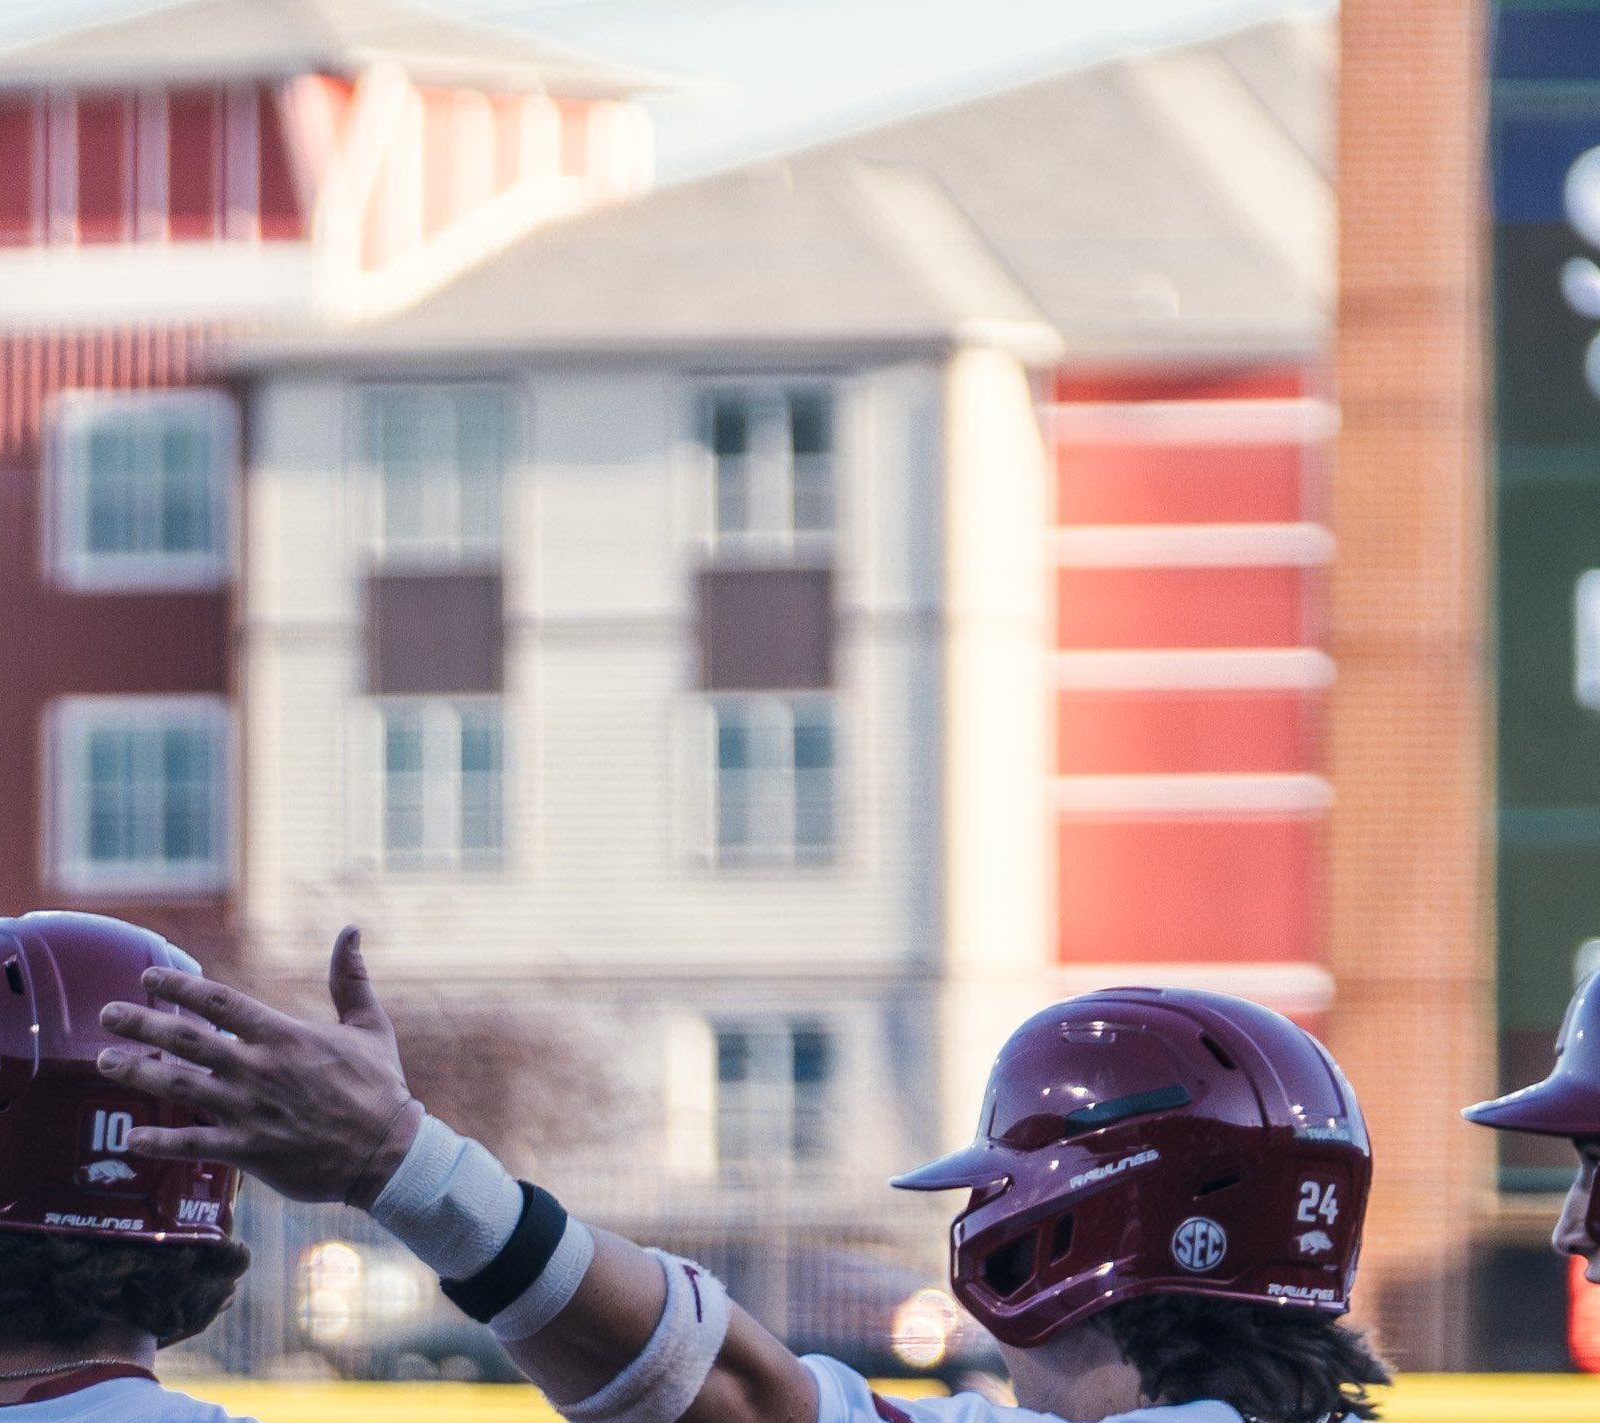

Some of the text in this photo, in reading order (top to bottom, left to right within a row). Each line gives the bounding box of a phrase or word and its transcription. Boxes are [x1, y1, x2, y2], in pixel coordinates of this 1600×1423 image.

[92, 1109, 133, 1153] 10
[44, 1211, 145, 1232] RAWLINGS
[1297, 1180, 1339, 1225] 24
[1175, 1218, 1225, 1270] SEC
